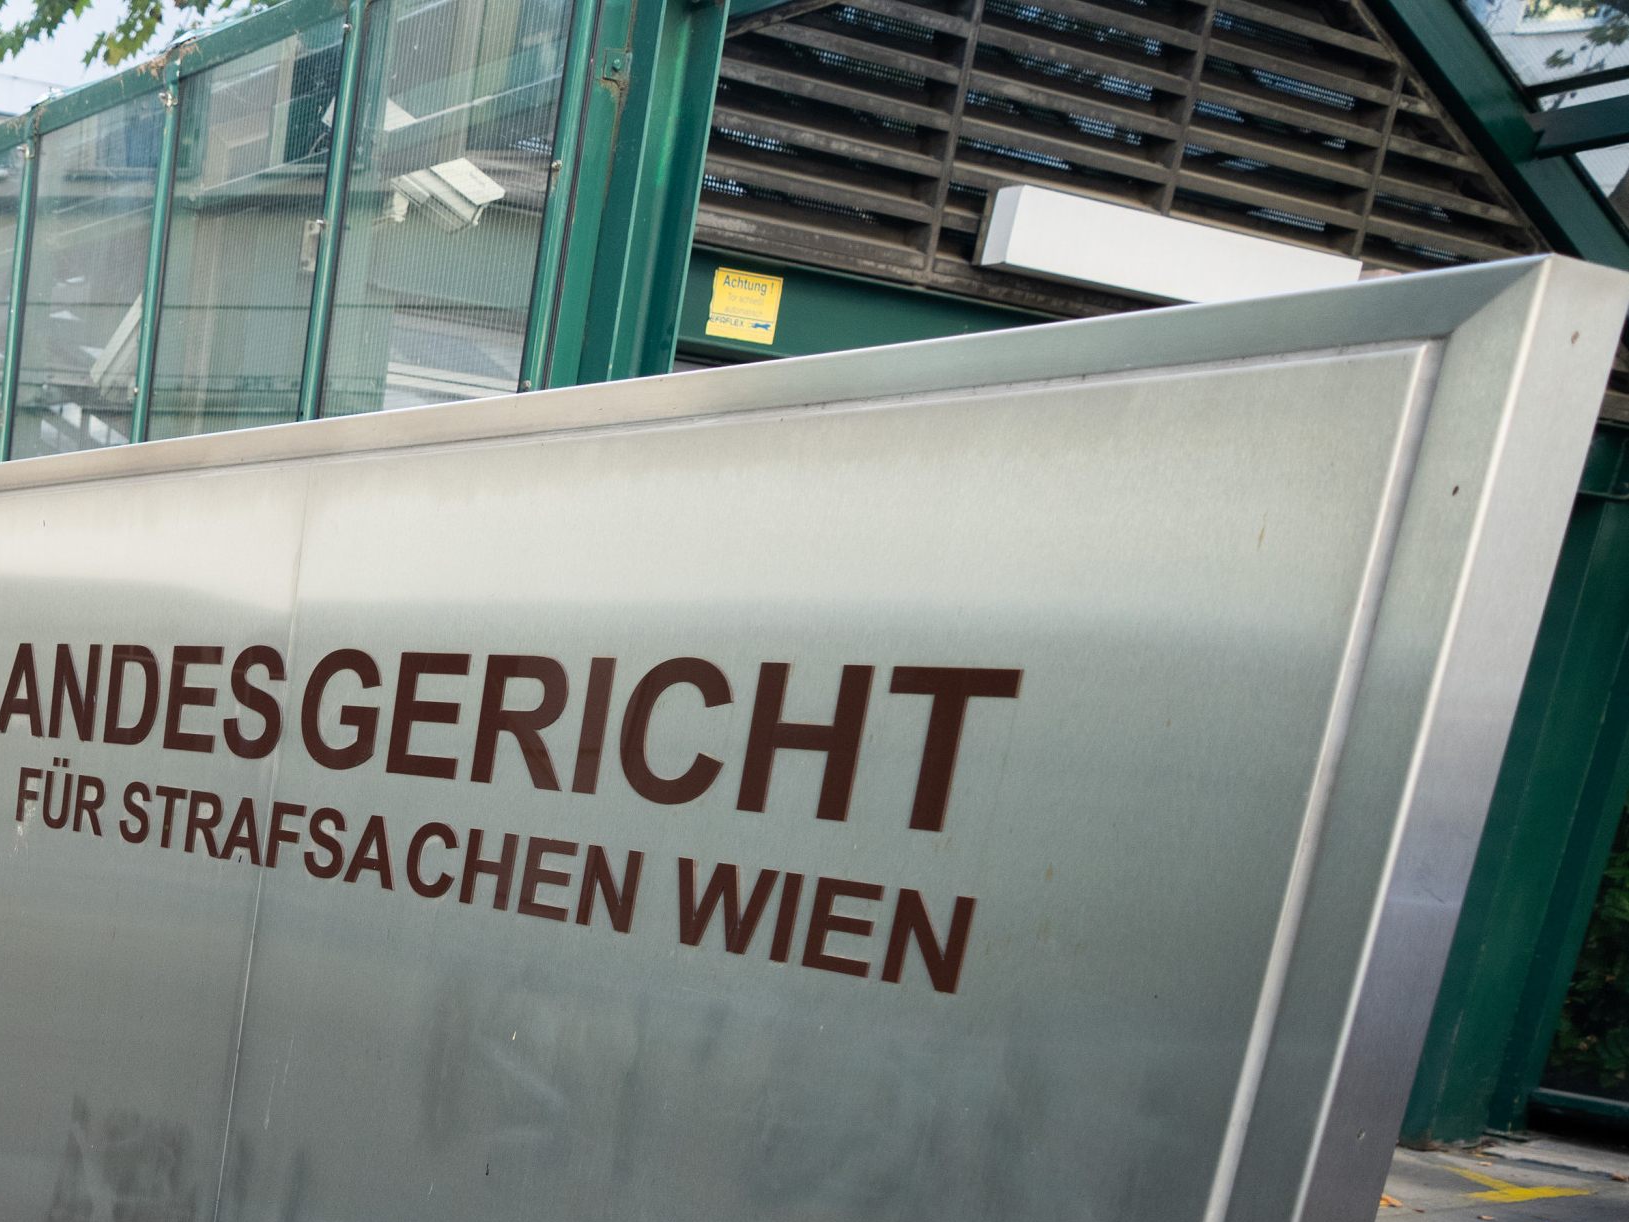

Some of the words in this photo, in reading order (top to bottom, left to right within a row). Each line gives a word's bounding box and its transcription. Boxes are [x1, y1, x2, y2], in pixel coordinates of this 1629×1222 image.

[723, 274, 768, 296] Achtung
[15, 758, 105, 836] FÜR
[119, 781, 644, 933] STRAFSACHEN
[678, 857, 976, 994] WIEN
